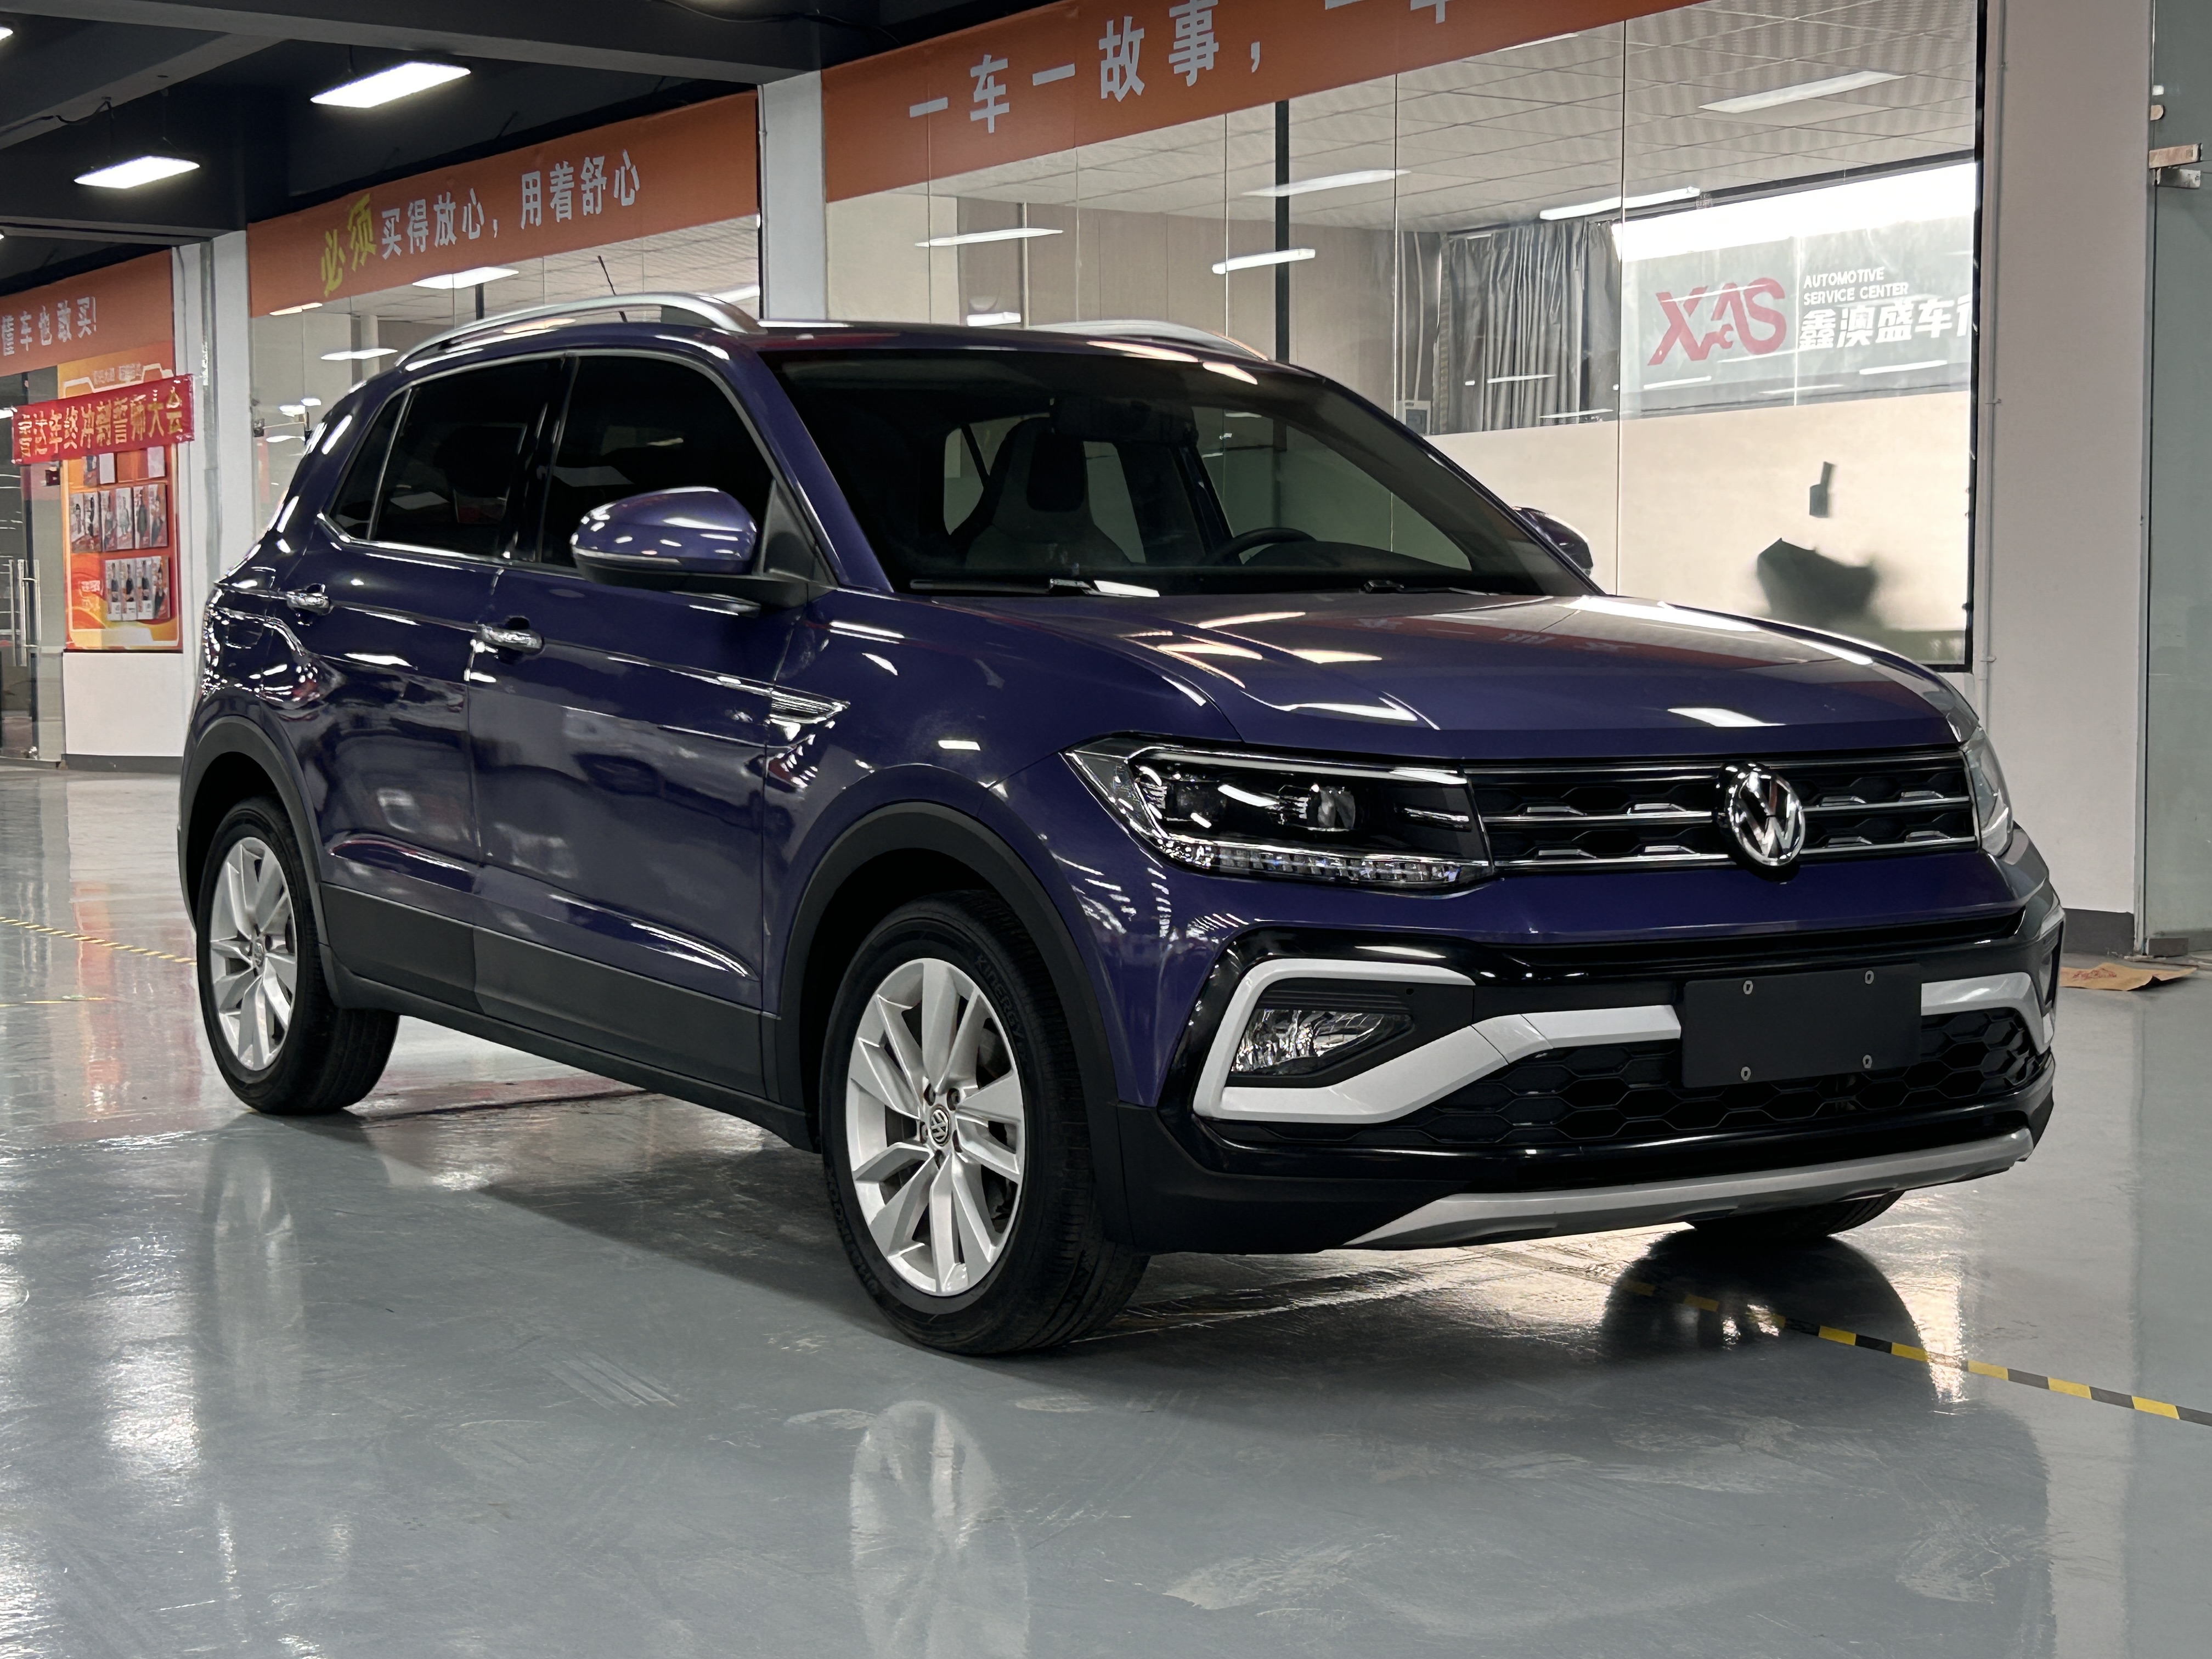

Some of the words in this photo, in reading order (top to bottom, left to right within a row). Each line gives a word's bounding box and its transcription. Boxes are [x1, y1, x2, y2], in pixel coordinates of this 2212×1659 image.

[1803, 267, 1885, 289] AUTOMOTIVE
[1803, 287, 1855, 306] SERVICE
[1859, 282, 1909, 300] CENTER
